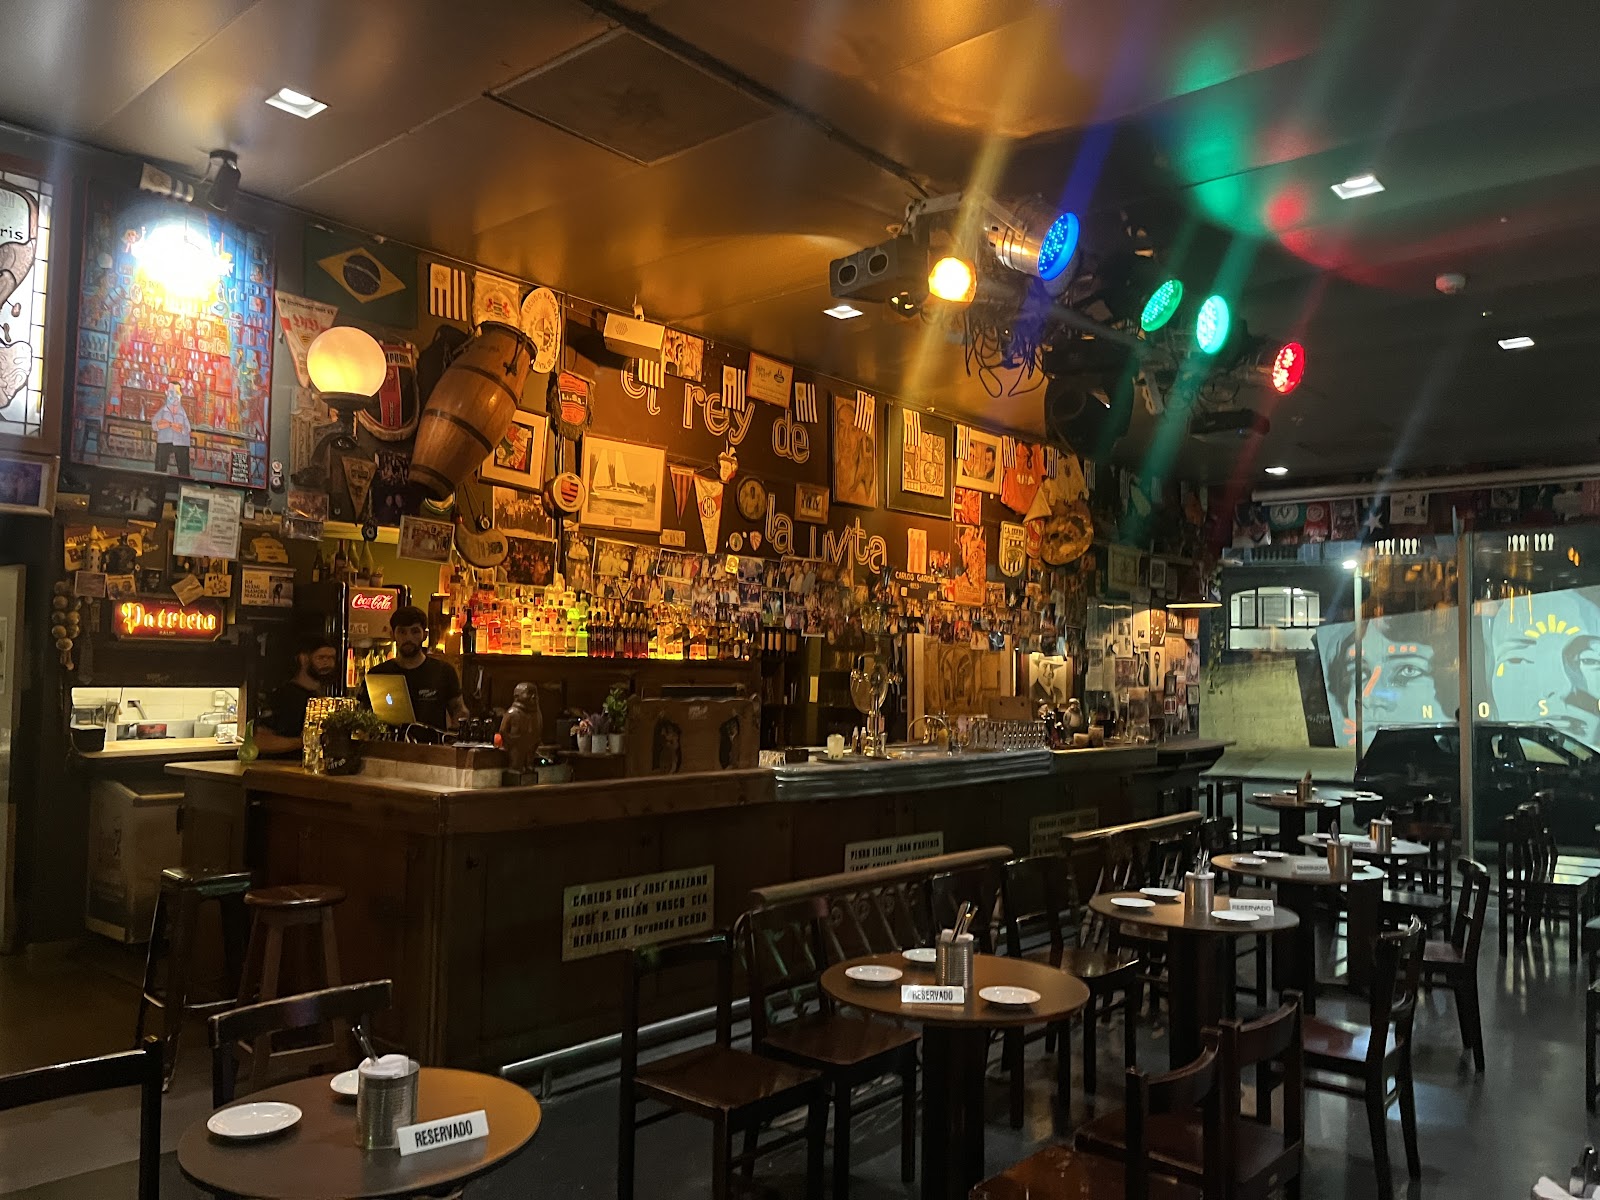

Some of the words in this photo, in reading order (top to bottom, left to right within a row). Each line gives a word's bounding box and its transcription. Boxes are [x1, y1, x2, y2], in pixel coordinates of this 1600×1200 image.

[772, 407, 810, 464] de
[764, 492, 795, 557] la
[895, 571, 914, 581] CARLOS
[917, 574, 937, 584] GARDEL
[352, 593, 394, 610] Coca-Cola
[121, 602, 217, 635] Patricia
[573, 890, 611, 907] CARLOS
[643, 879, 667, 895] JOSÉ
[571, 909, 599, 928] JOSÉ
[602, 911, 610, 922] P.
[656, 898, 684, 911] VASCO
[691, 893, 707, 906] CEA
[1231, 904, 1272, 912] RESERVADO
[912, 989, 954, 1002] RESERVADO
[414, 1119, 473, 1148] RESERVADO
